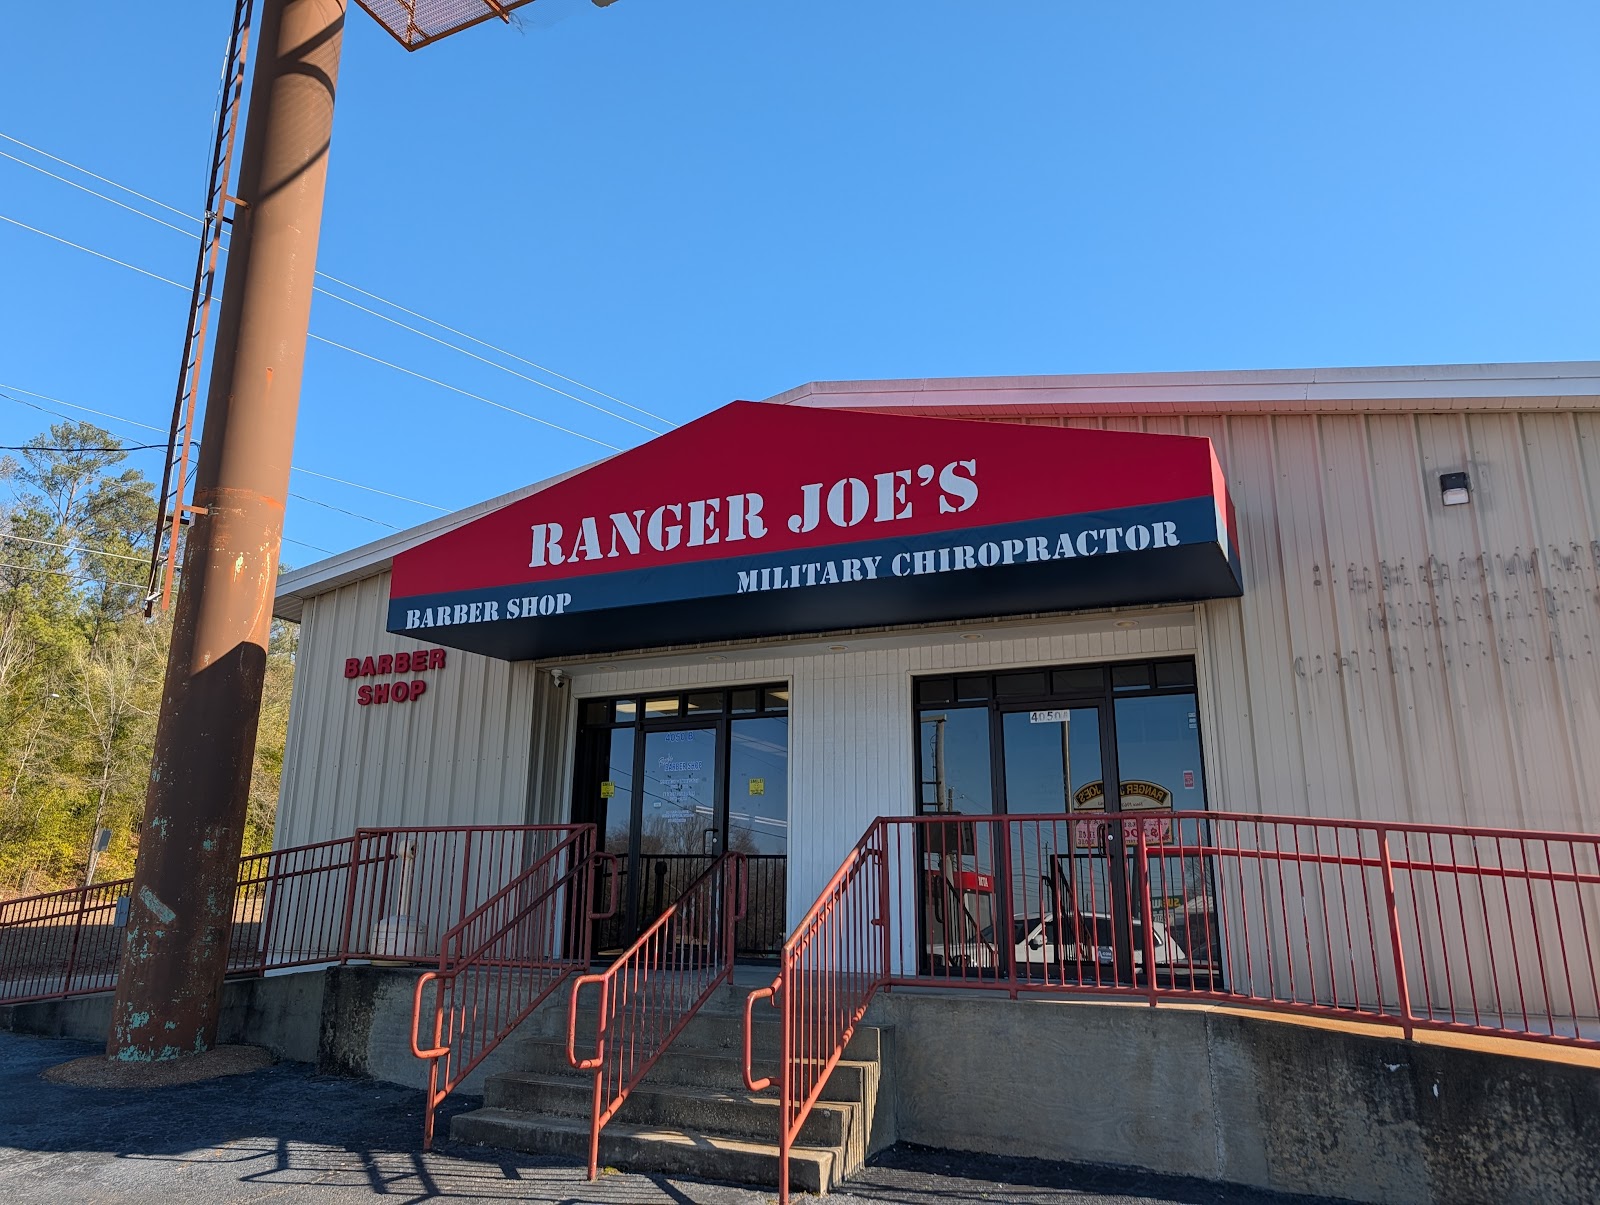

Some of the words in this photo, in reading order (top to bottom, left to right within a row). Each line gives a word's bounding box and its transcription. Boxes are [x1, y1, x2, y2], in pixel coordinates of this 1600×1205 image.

[528, 491, 768, 568] RANGER
[786, 456, 979, 534] JOE’S
[737, 554, 882, 594] MILITARY
[891, 520, 1180, 578] CHIROPRACTOR
[405, 601, 500, 630] BARBER
[506, 593, 572, 620] SHOP
[344, 648, 447, 679] BARBER
[357, 679, 427, 706] SHOP
